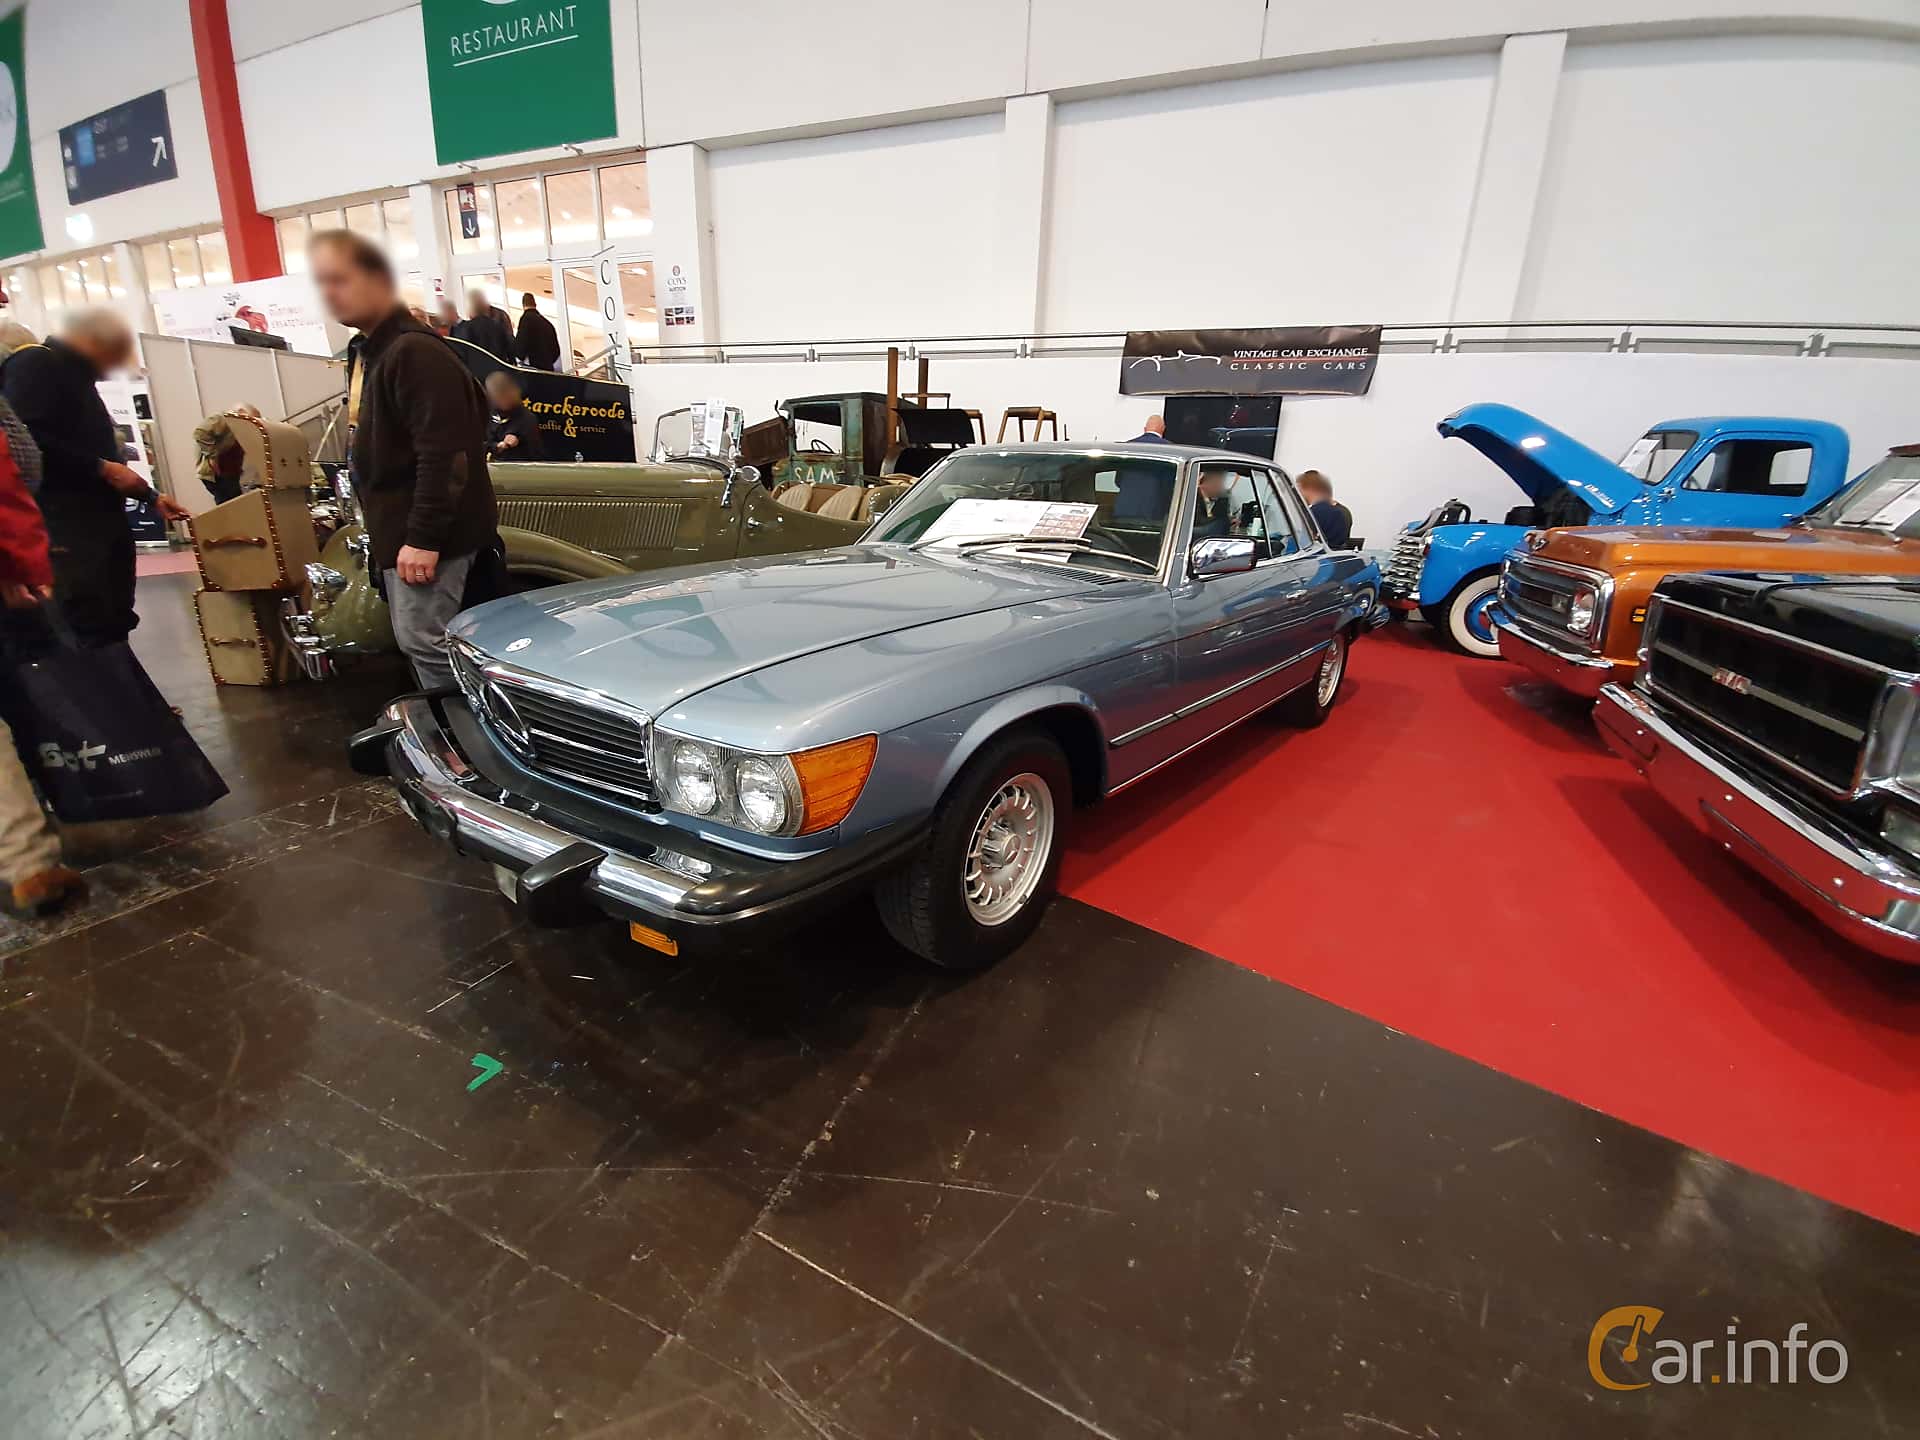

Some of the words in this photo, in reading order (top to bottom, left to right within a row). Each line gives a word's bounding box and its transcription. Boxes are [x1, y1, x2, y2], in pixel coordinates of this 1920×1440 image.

[450, 5, 577, 57] RESTAURANT
[1233, 350, 1278, 359] VINTAGE
[1281, 349, 1304, 358] CAR
[1306, 347, 1369, 357] EXCHANGE
[1230, 362, 1308, 370] CLASSIC
[1323, 362, 1367, 370] CARS
[522, 396, 625, 419] tarckeroode
[563, 418, 578, 438] &
[794, 466, 836, 487] SAM
